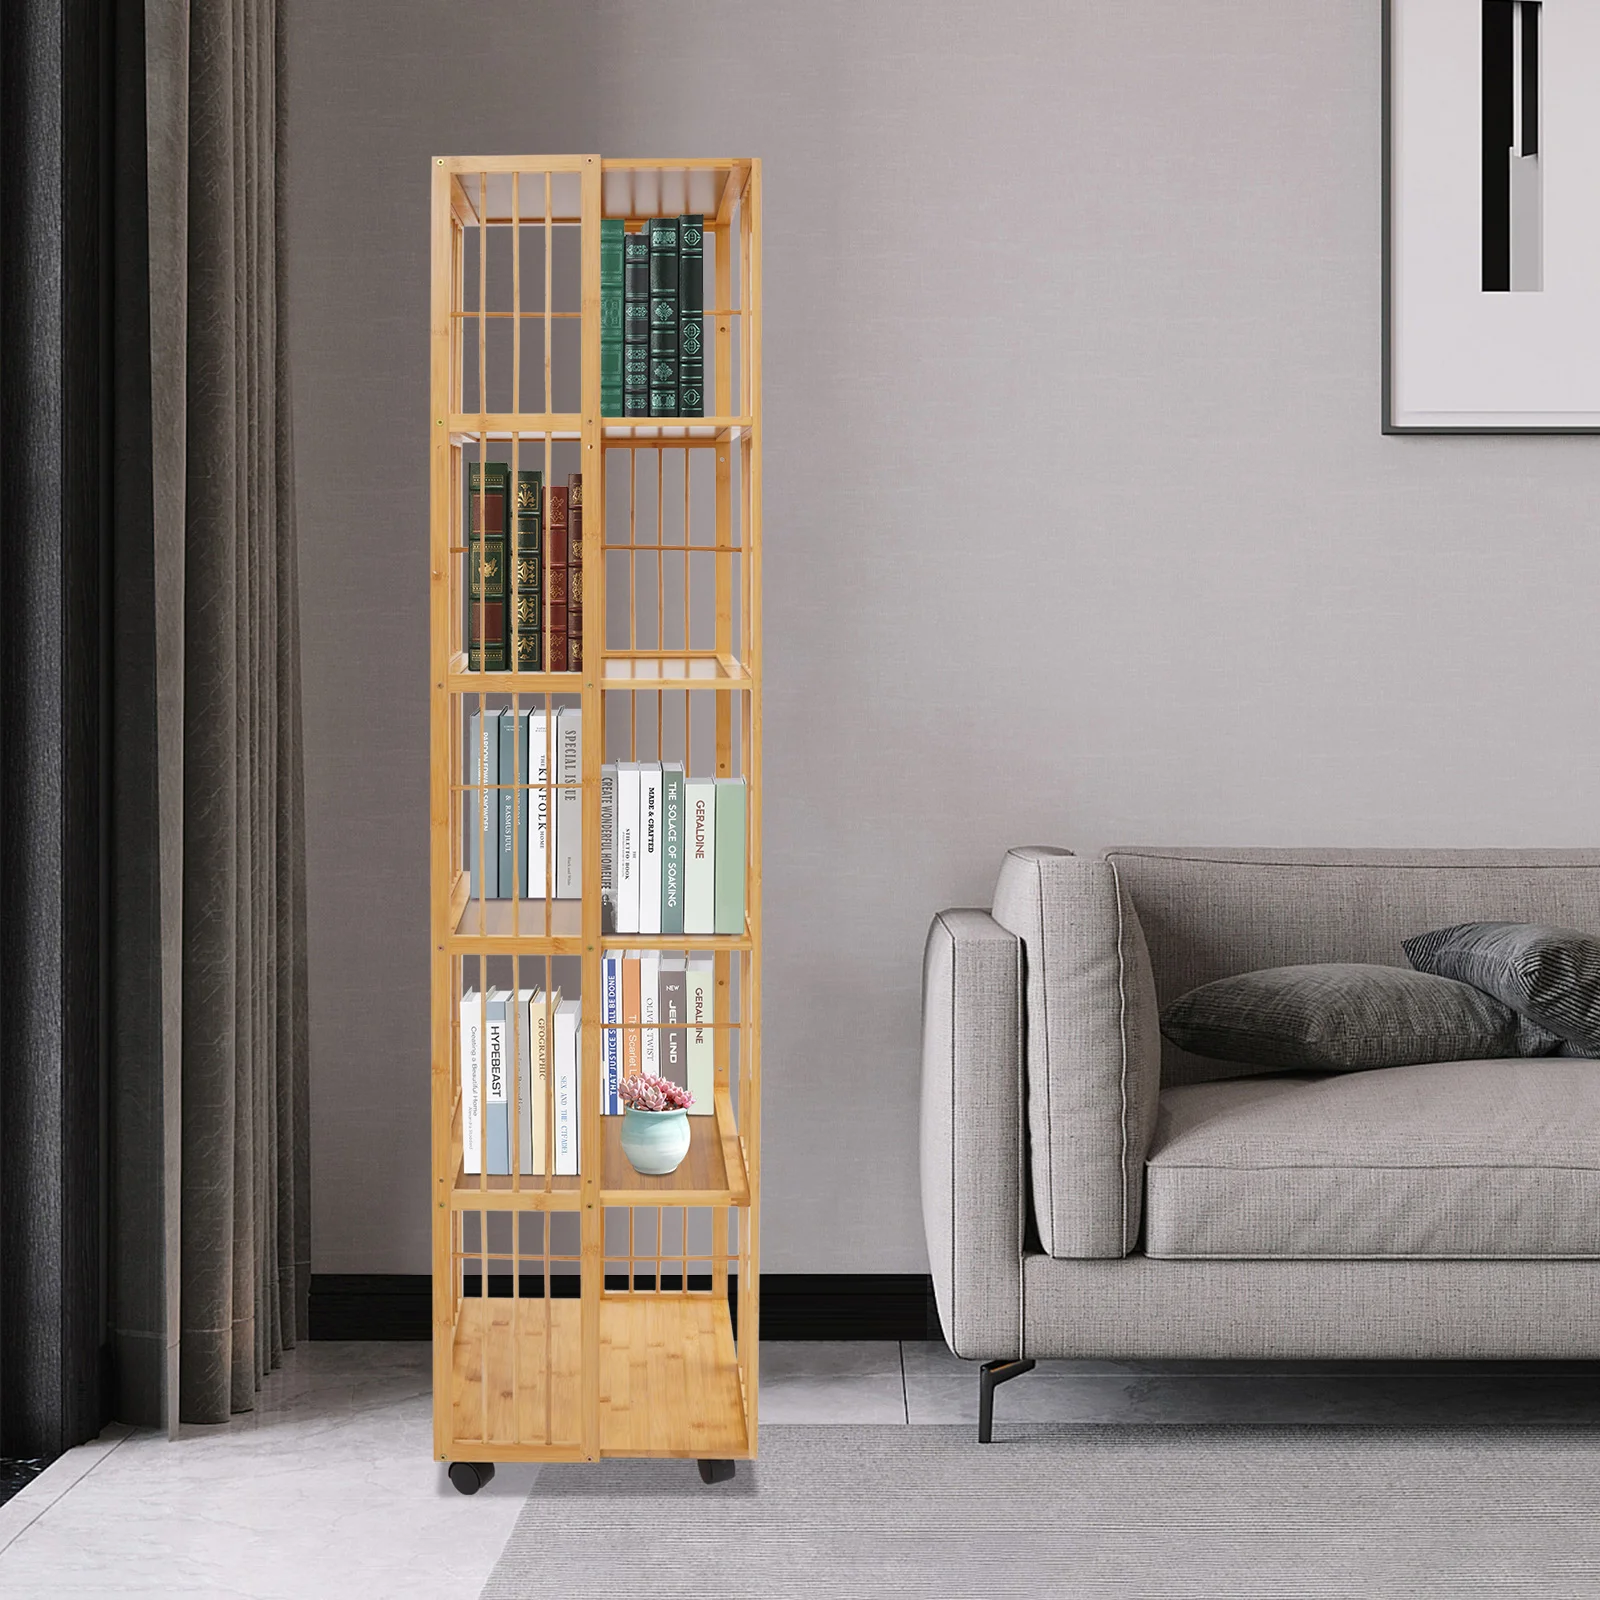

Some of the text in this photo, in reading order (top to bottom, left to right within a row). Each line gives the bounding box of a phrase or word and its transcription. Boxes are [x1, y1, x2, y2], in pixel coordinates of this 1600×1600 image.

[564, 730, 577, 801] SPECIAL ISUE
[601, 777, 613, 804] CREATE
[504, 834, 512, 853] JUUL
[601, 805, 613, 851] WONDERFUL
[668, 781, 677, 907] THE SOLACE OF SOAKING
[696, 800, 705, 859] GERALDINE
[601, 853, 612, 889] HOMELIFE
[608, 999, 616, 1009] BE
[608, 1010, 616, 1035] SALL
[470, 1026, 478, 1056] Creating
[628, 1034, 637, 1067] Scarlet
[669, 1032, 677, 1064] LIND
[491, 1026, 501, 1097] HYPEBEAST
[560, 1092, 568, 1106] AND
[609, 1073, 617, 1096] THAT
